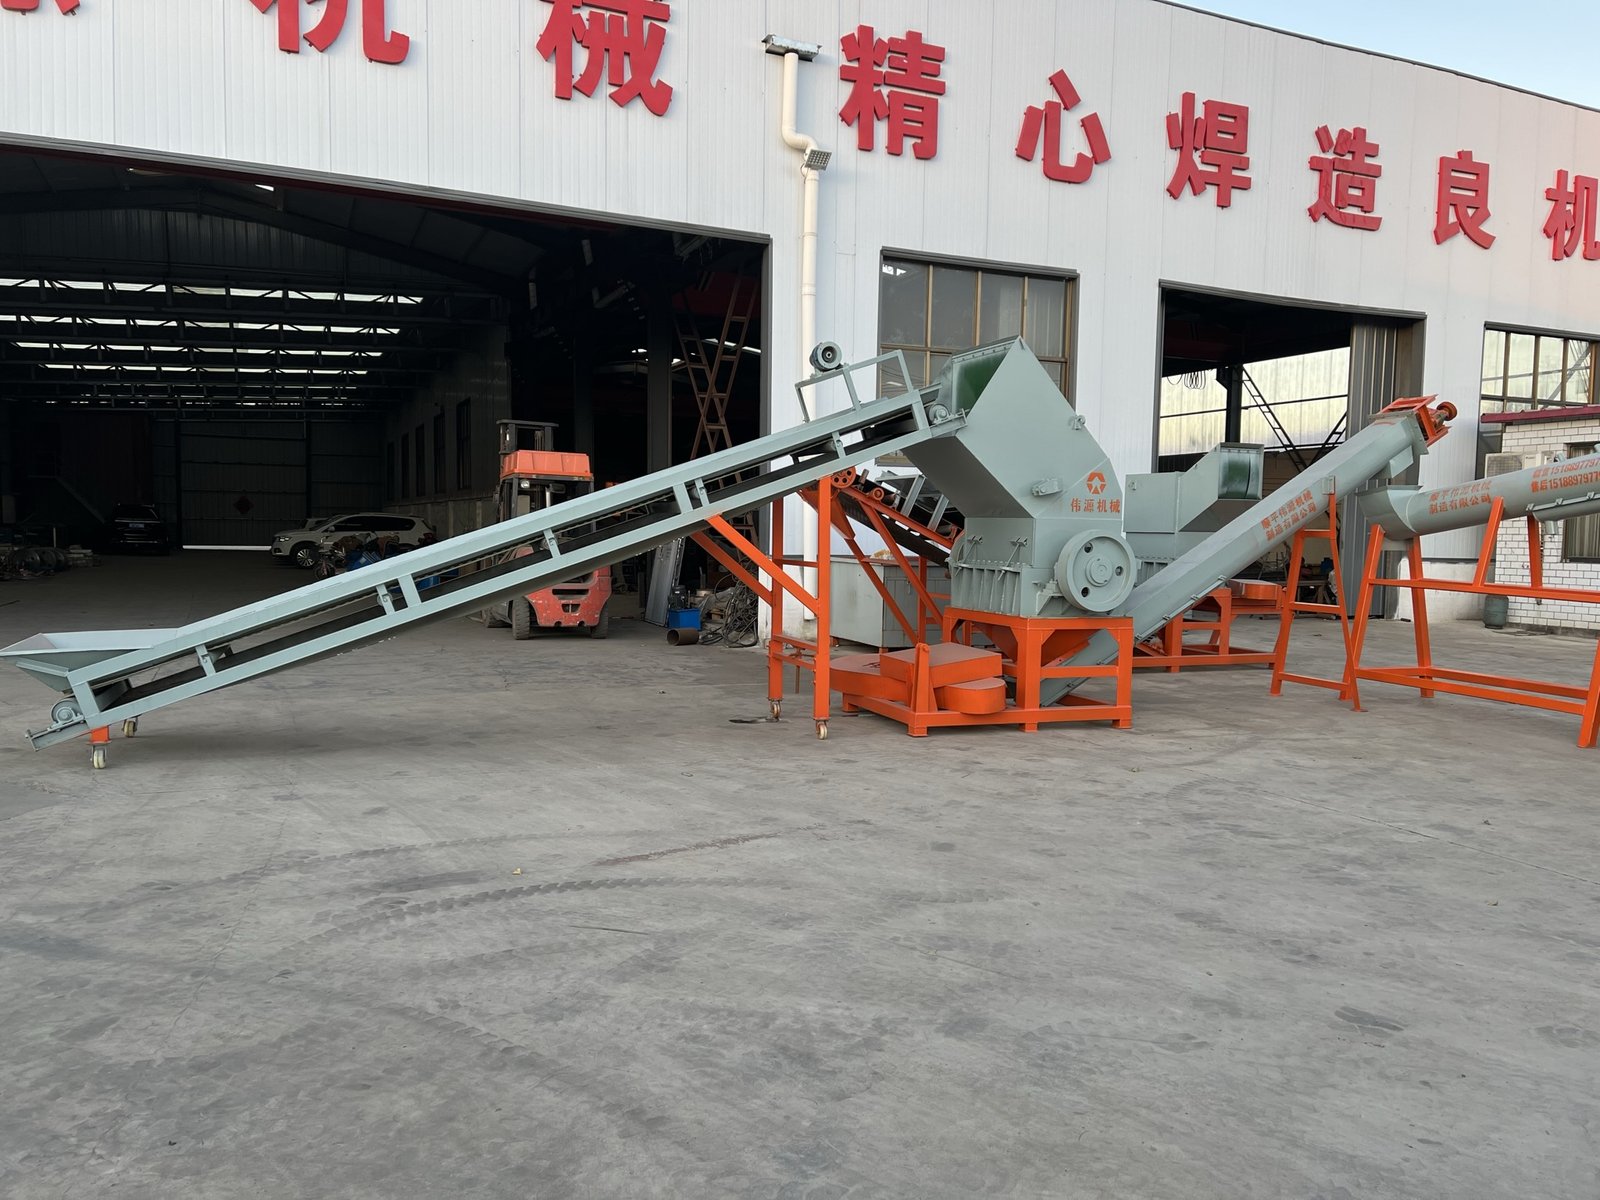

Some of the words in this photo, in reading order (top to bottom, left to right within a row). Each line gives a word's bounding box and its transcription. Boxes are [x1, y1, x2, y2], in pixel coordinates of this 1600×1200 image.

[1071, 498, 1121, 513] 伟源机械
[1429, 493, 1491, 515] 制造有限公司
[1266, 501, 1317, 541] 制造有限公司
